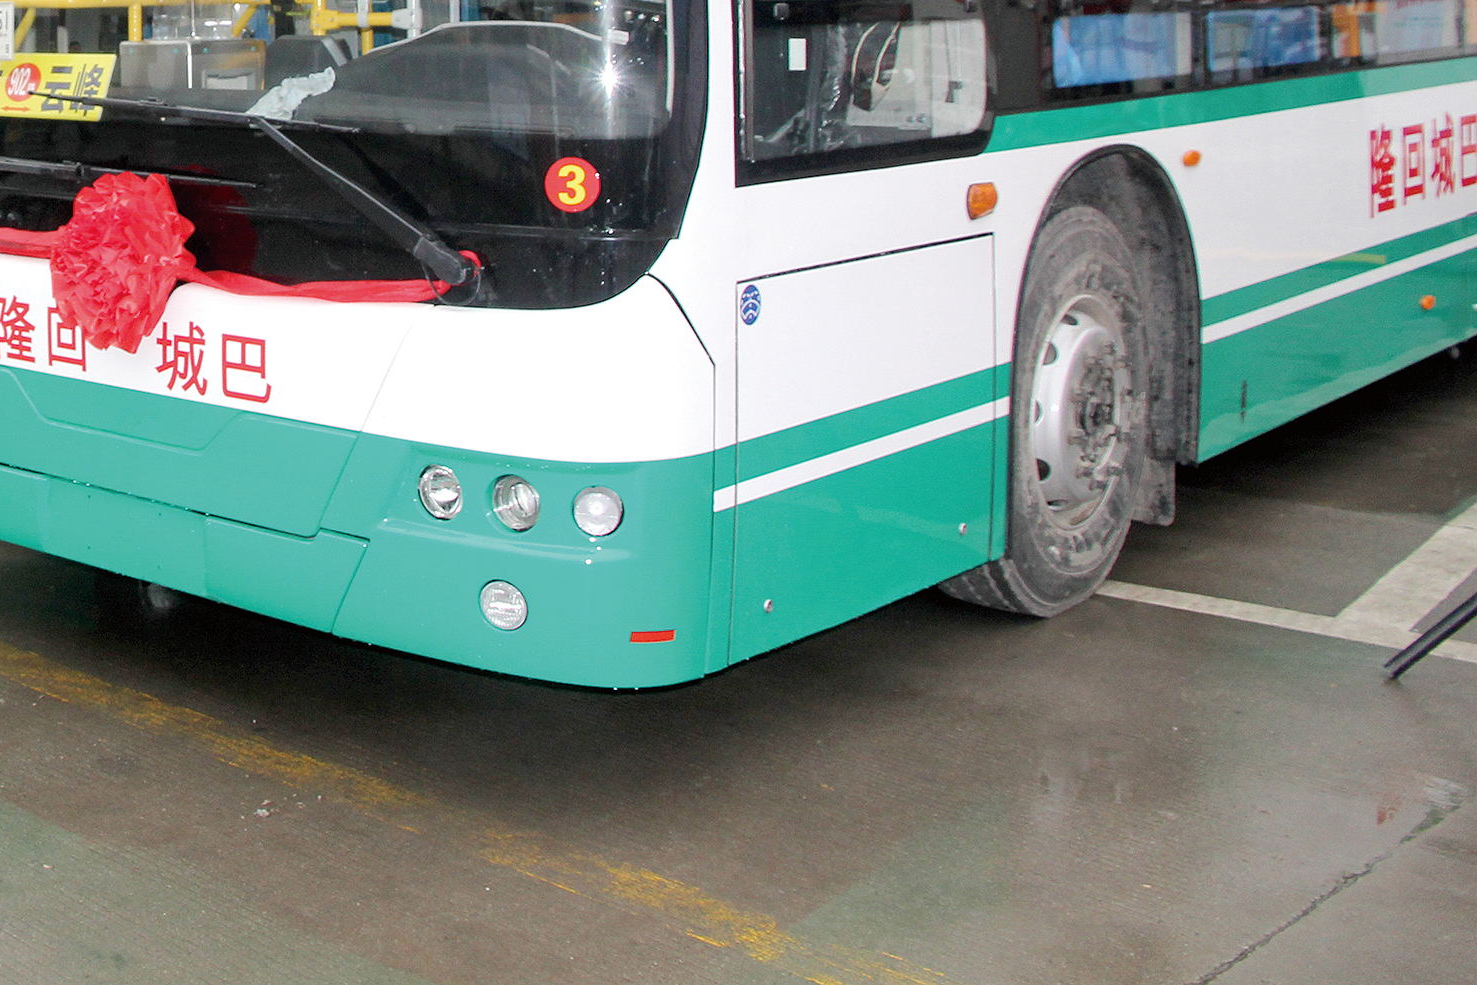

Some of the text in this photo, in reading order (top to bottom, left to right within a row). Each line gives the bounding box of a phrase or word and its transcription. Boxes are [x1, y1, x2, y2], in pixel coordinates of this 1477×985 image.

[41, 64, 104, 117] 云峰
[557, 163, 588, 206] 3
[156, 321, 272, 404] 城巴
